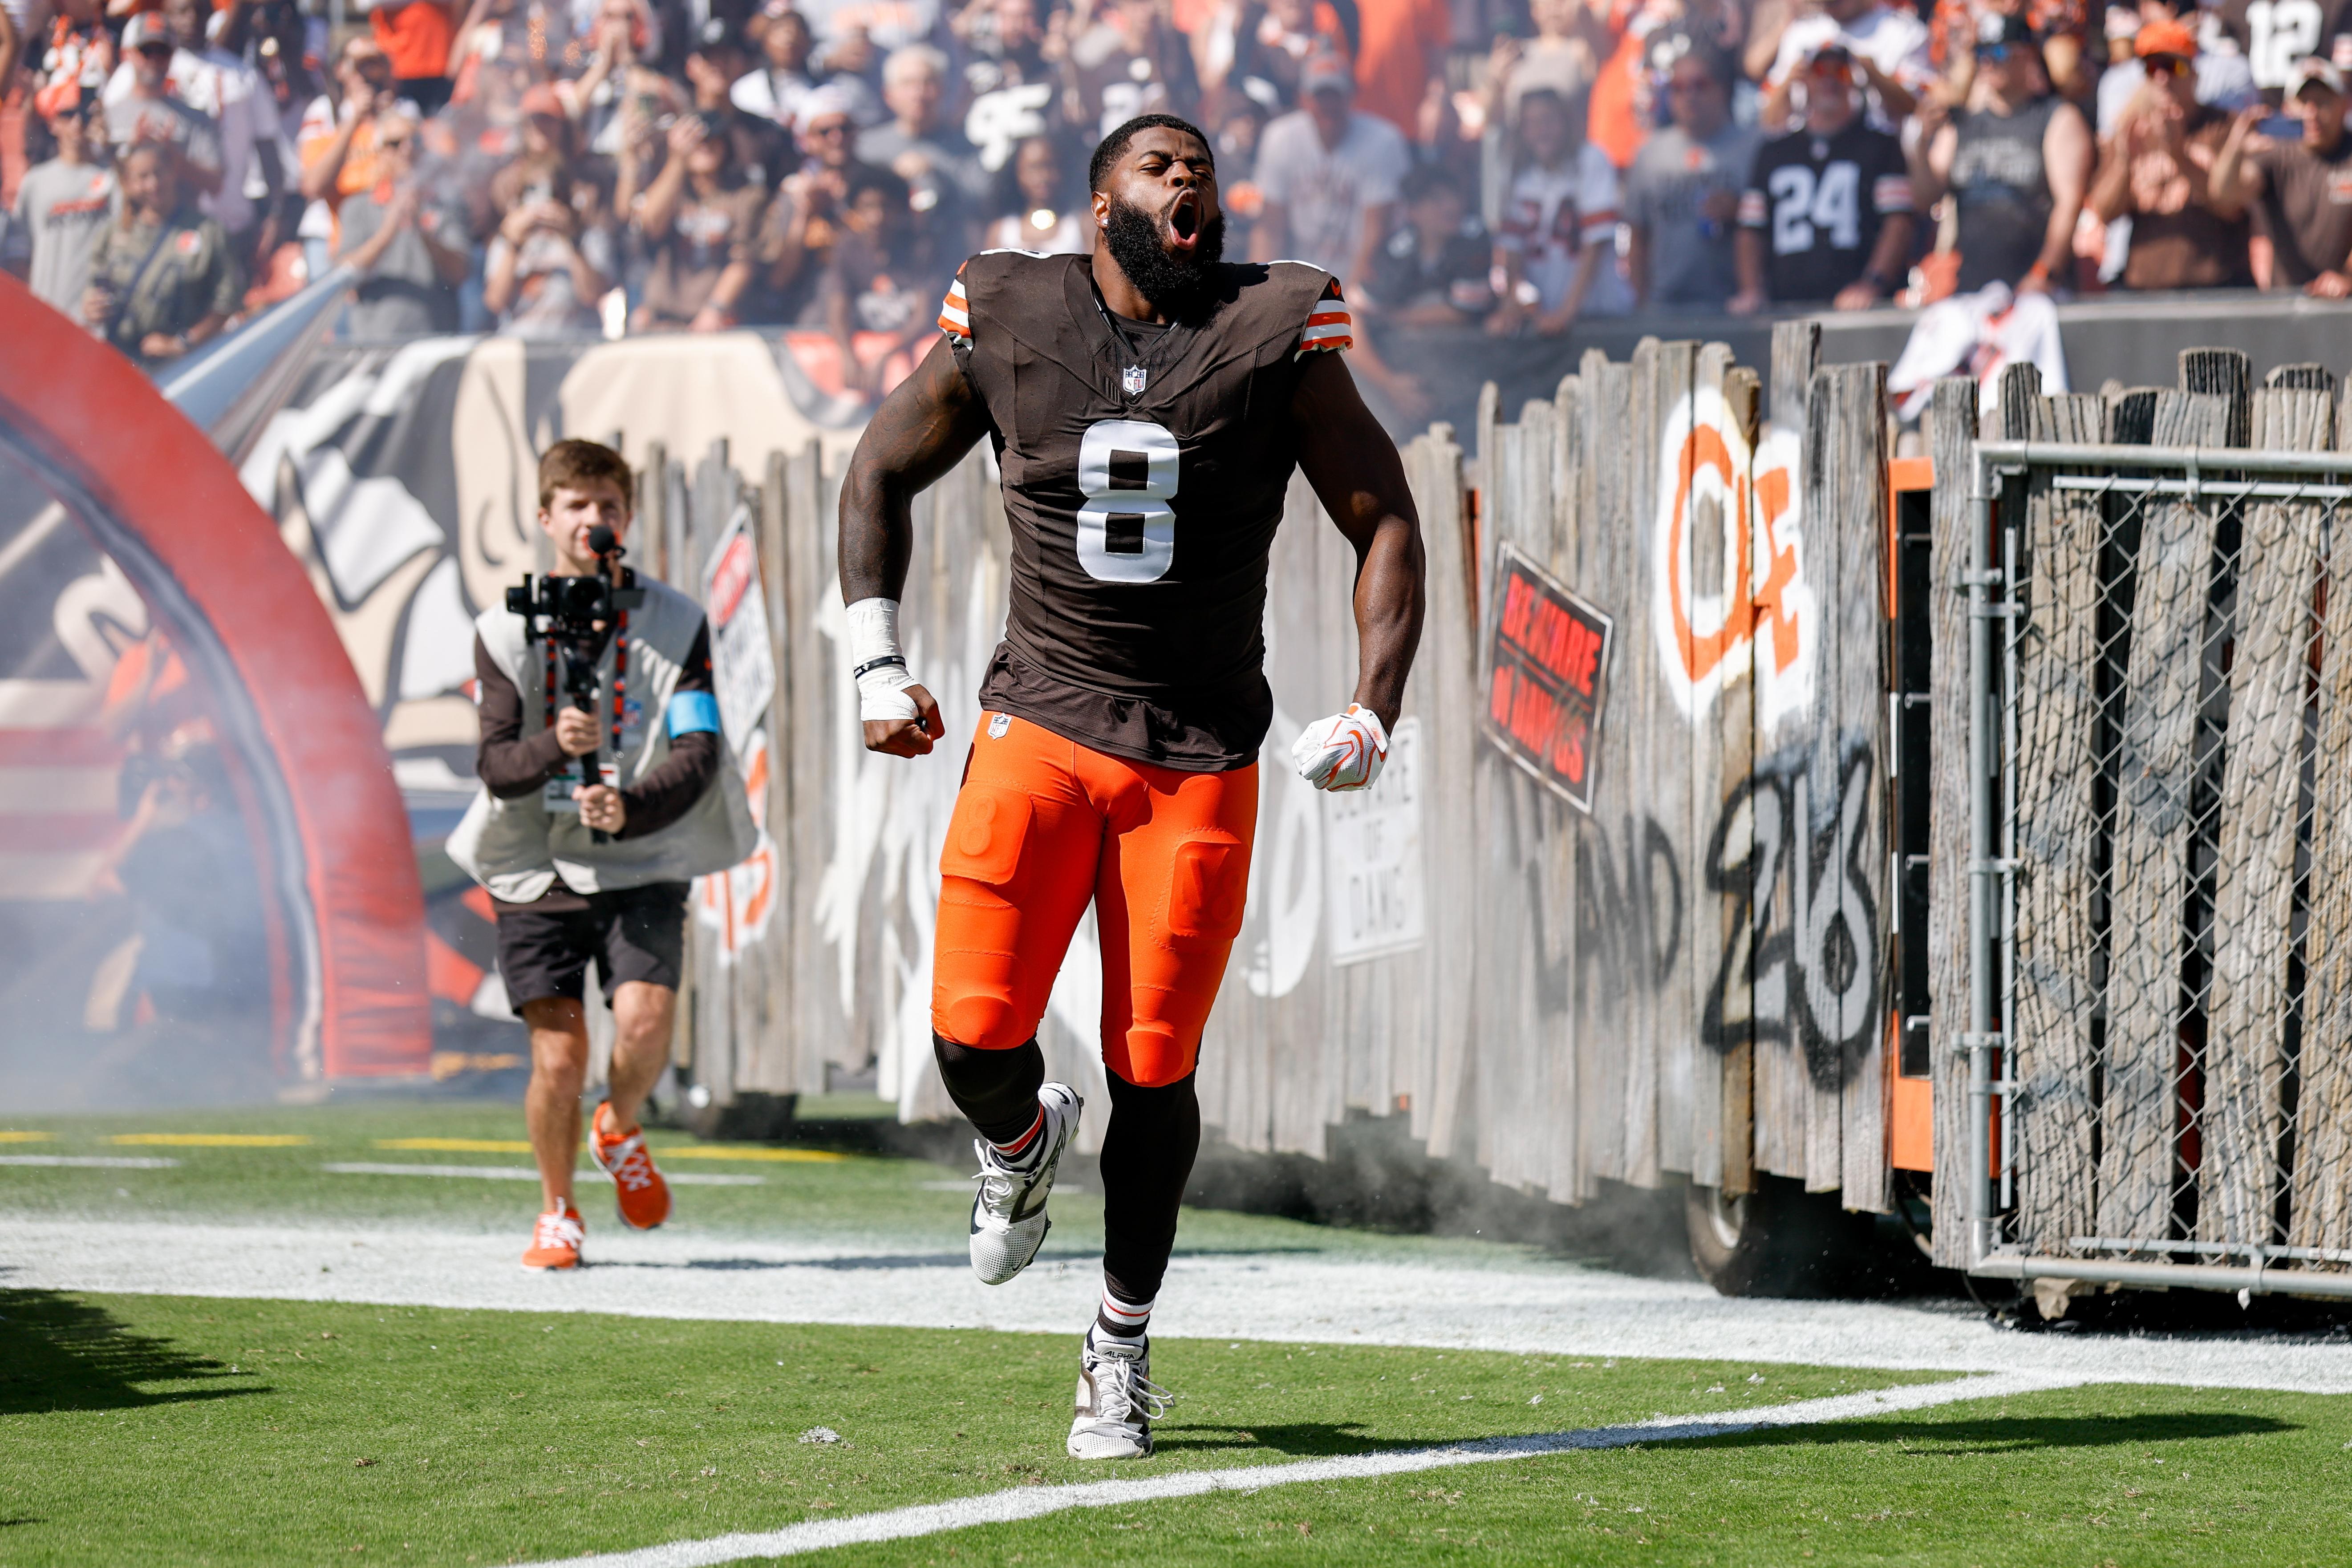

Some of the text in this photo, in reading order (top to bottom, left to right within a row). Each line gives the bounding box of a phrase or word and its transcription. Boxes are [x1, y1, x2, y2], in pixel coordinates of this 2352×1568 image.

[2245, 0, 2323, 89] 12
[1769, 160, 1861, 255] 24
[1127, 379, 1142, 389] NFL
[1077, 419, 1180, 583] 8
[1500, 572, 1602, 698] BEWARE
[959, 795, 997, 856] 8
[1528, 812, 1683, 1017] LAND
[1703, 748, 1877, 1090] 216
[1104, 1350, 1135, 1359] ALPHA
